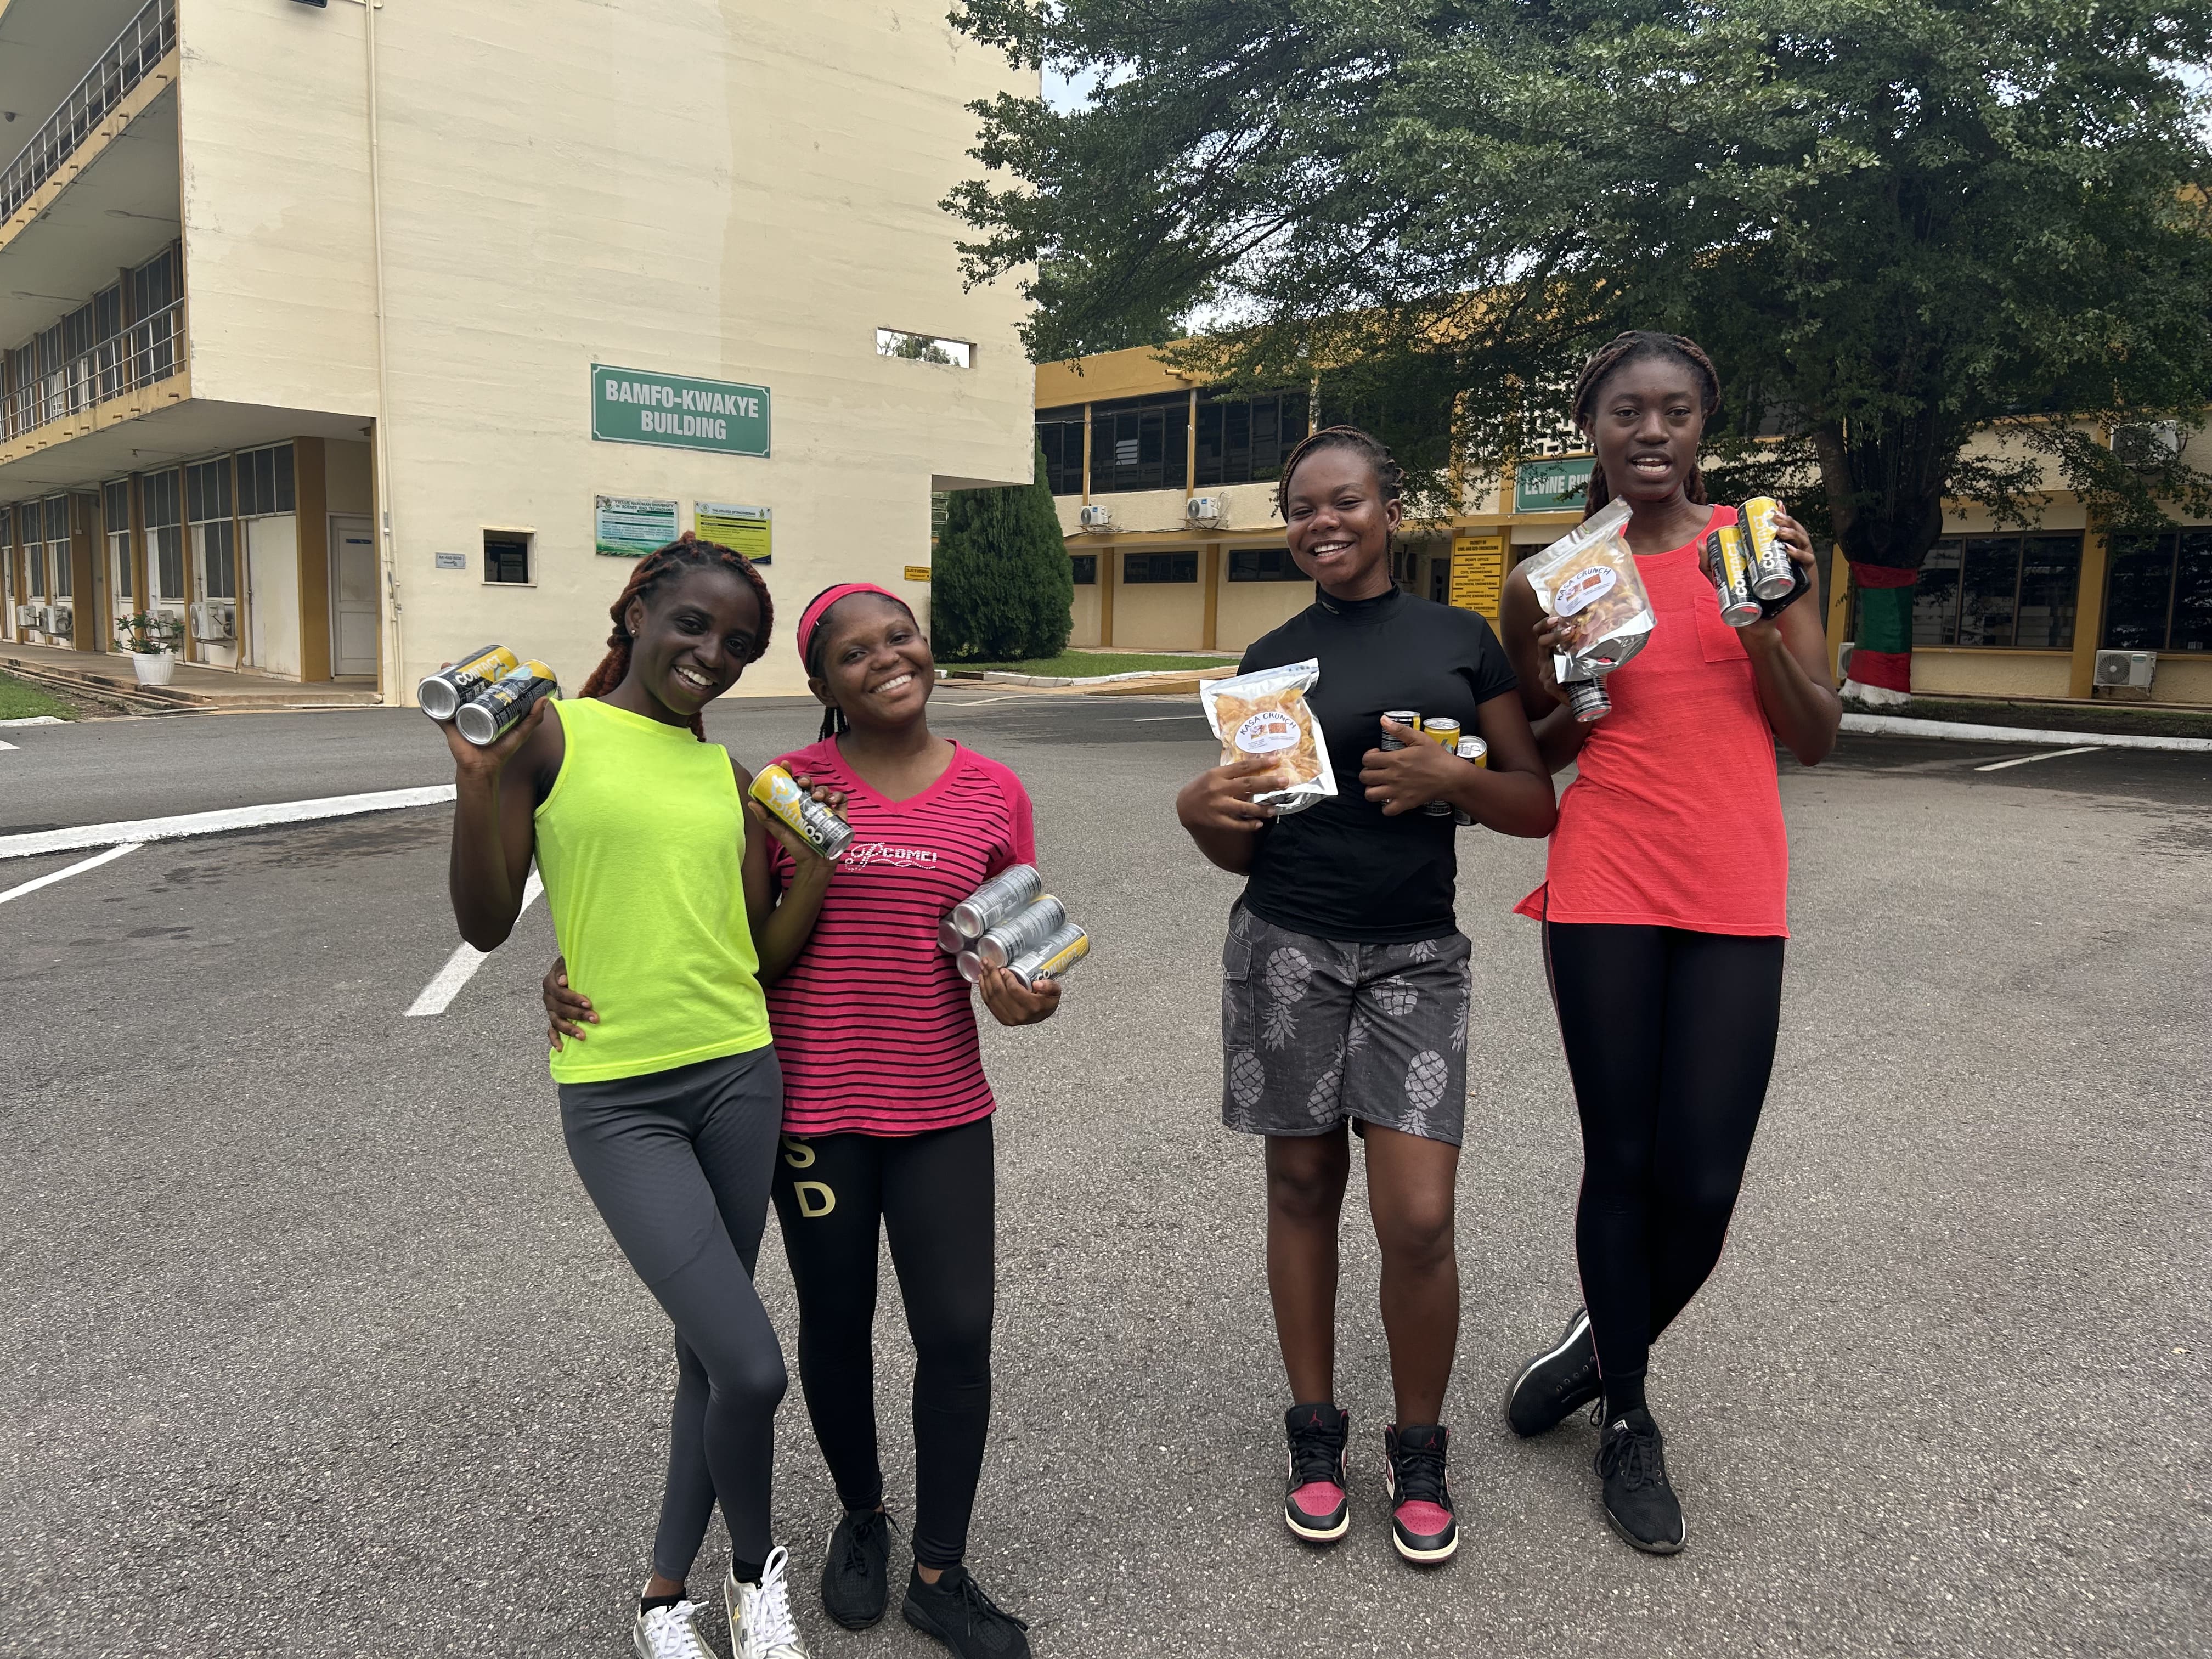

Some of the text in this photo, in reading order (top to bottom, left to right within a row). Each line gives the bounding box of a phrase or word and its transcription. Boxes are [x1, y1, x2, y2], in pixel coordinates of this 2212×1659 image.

[606, 380, 759, 418] BAMFO-KWAKYE
[641, 410, 726, 439] BUILDING
[1525, 475, 1565, 495] LEVINE
[1754, 515, 1775, 569] CONTACT
[1557, 580, 1574, 601] KASA
[1577, 567, 1611, 579] CRUNCH
[1726, 543, 1747, 596] CONTACT
[455, 655, 503, 686] CONTACT
[1240, 712, 1296, 735] KASA CRUNCH
[768, 795, 823, 844] CONTACT
